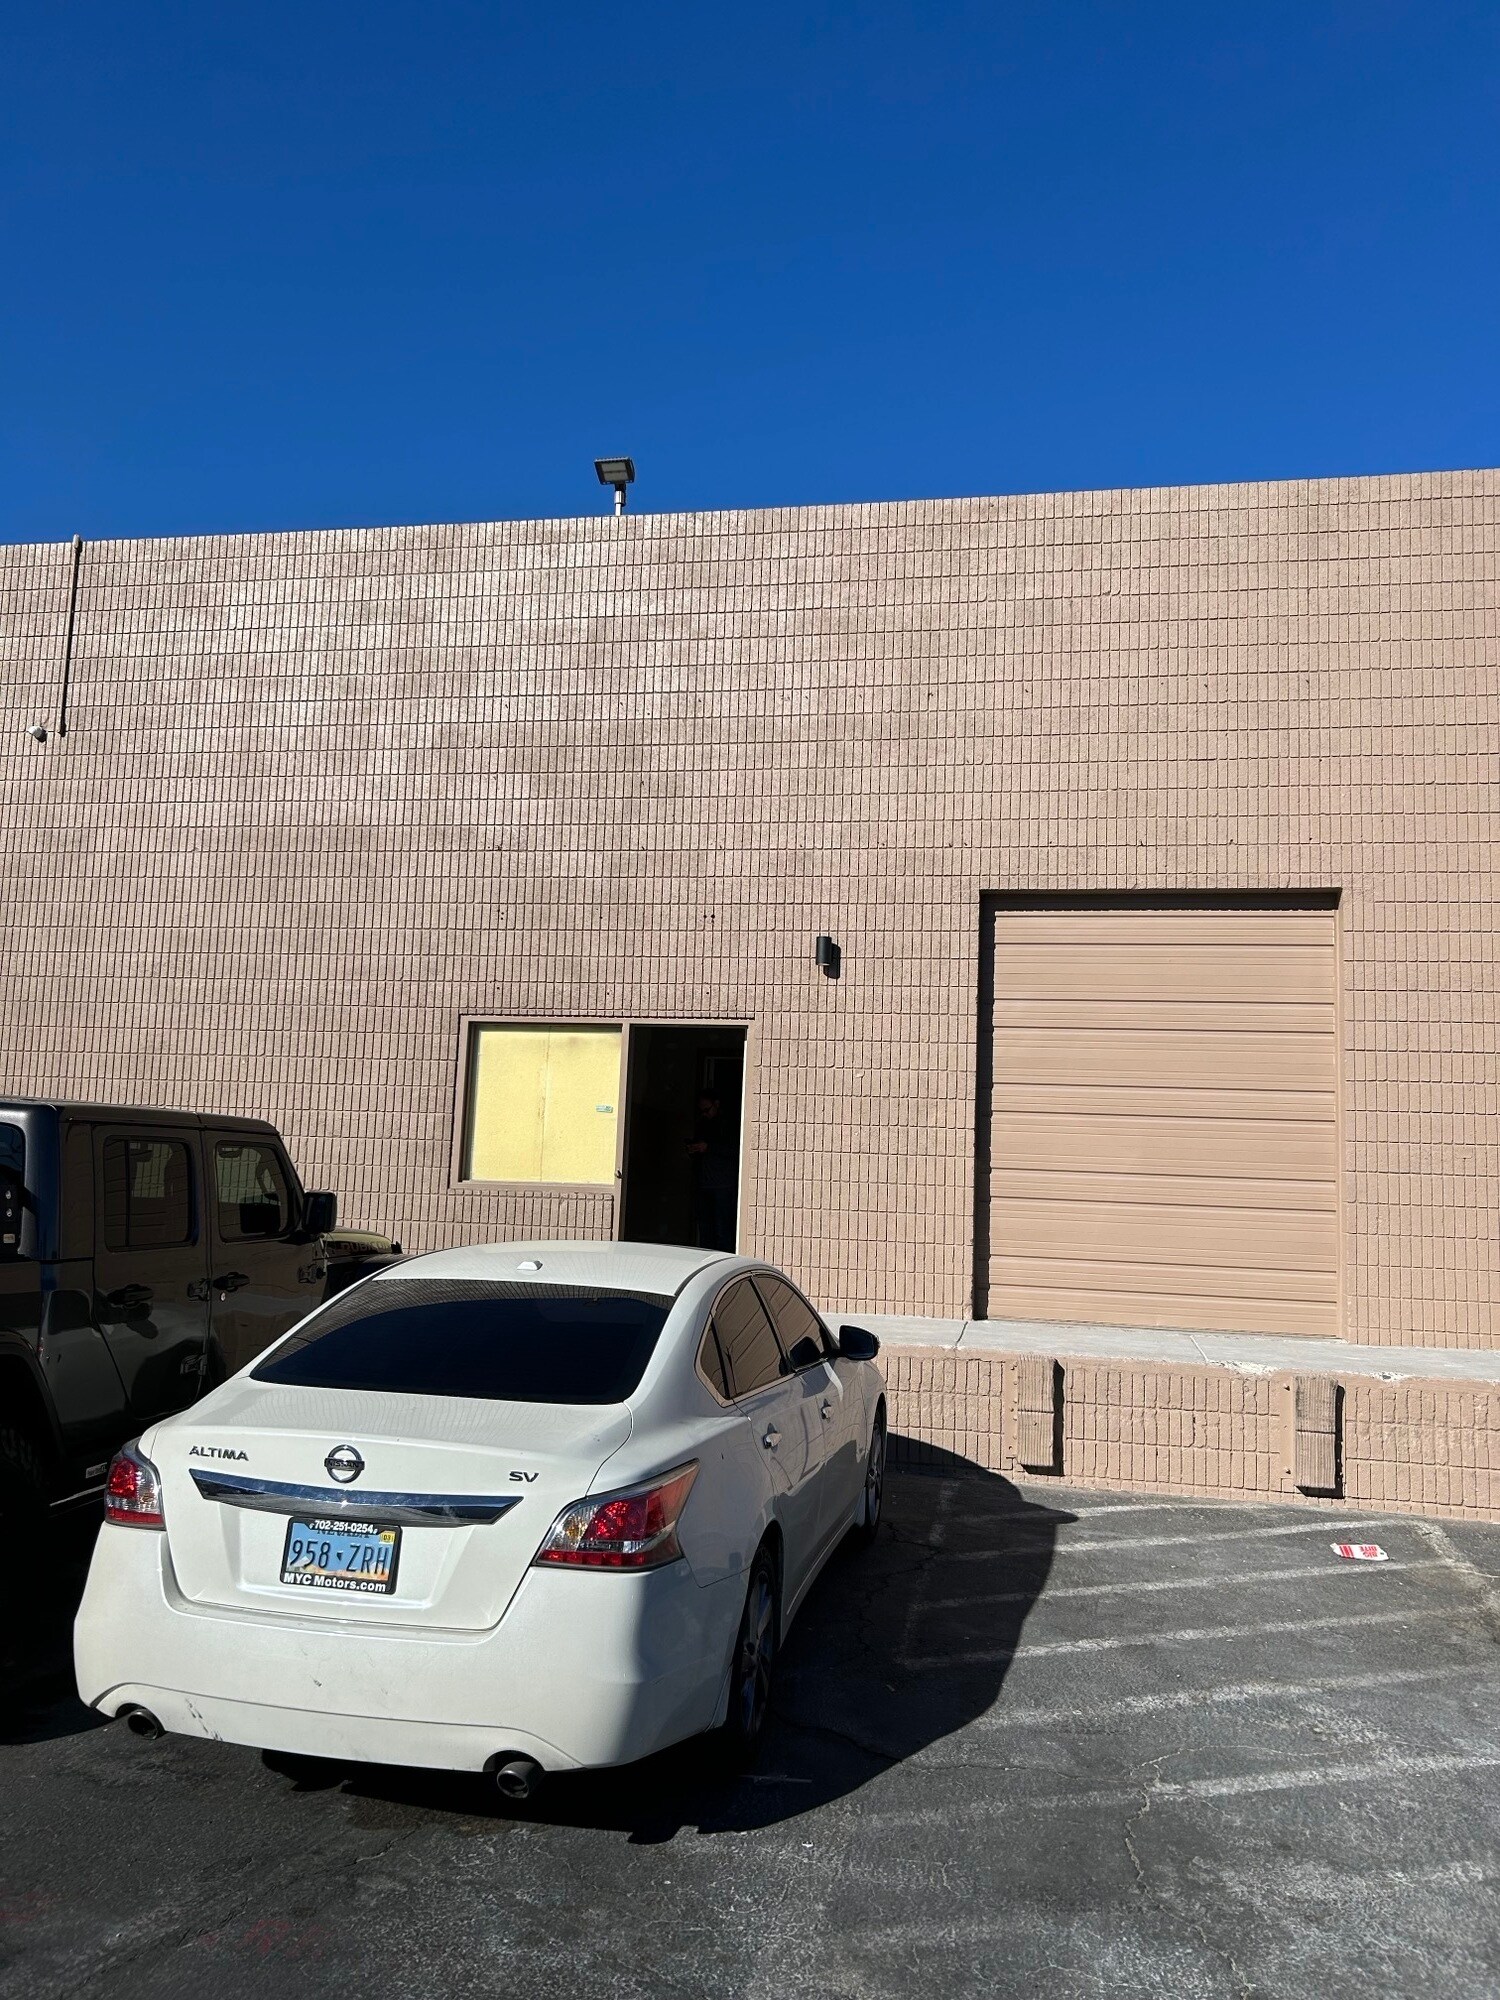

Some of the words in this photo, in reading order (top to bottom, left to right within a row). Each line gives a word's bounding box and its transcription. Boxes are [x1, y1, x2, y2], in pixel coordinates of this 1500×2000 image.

[189, 1445, 249, 1461] ALTIMA
[509, 1471, 539, 1482] SV
[315, 1520, 374, 1534] 702-251-0254
[290, 1539, 331, 1568] 958
[346, 1543, 390, 1575] ZRH
[284, 1573, 312, 1584] MYC
[313, 1576, 386, 1592] Motors.com
